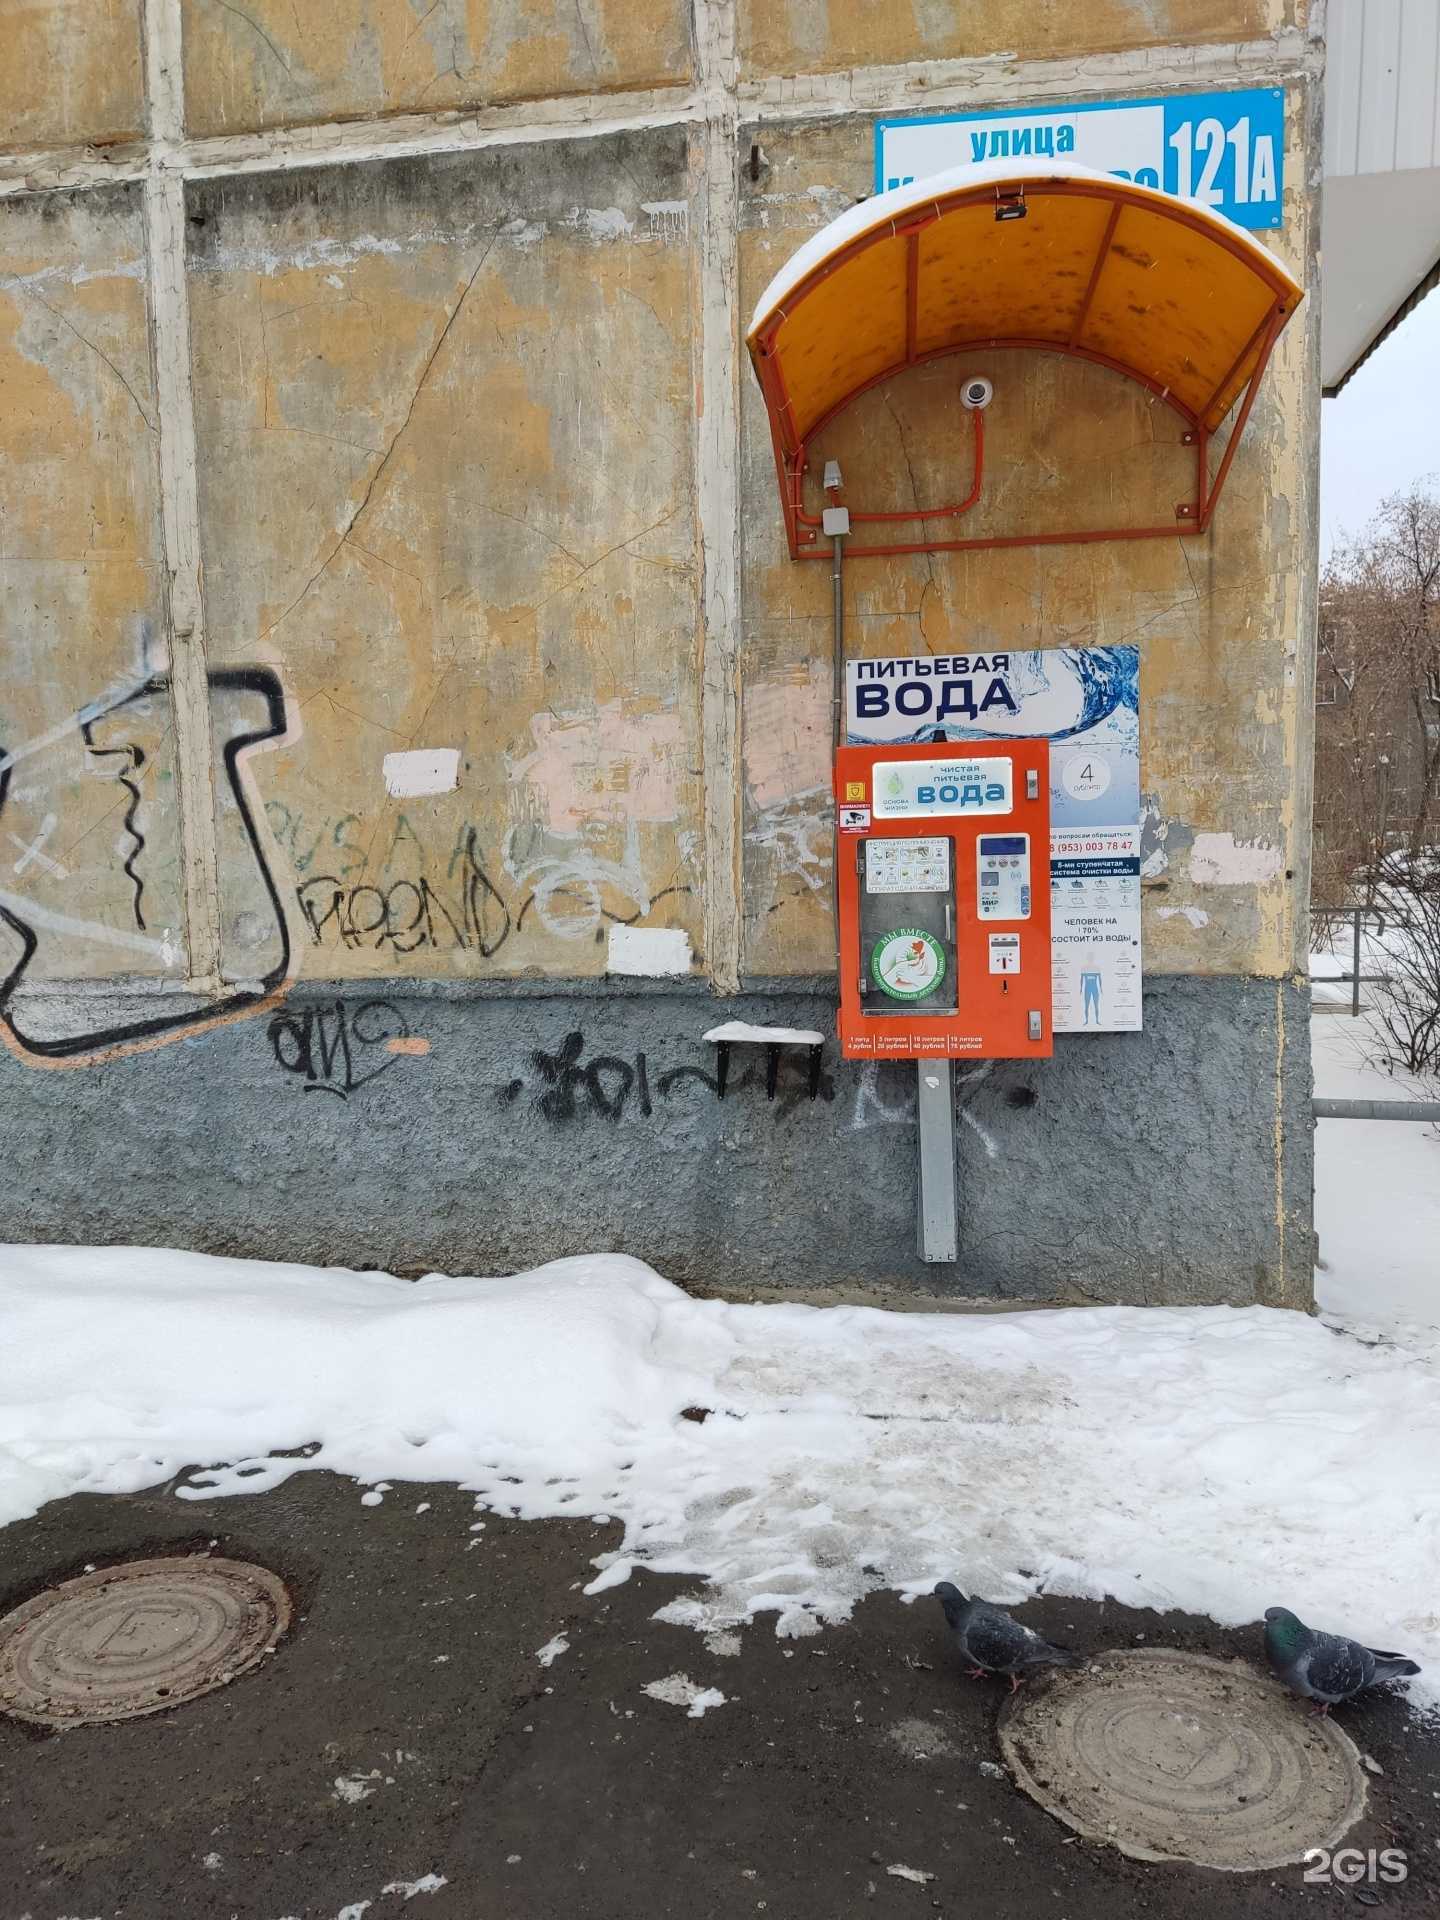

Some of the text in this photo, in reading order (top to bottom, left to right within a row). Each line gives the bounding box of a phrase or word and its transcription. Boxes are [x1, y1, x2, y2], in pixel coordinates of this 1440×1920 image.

[970, 124, 1075, 163] улица
[1169, 116, 1277, 206] 121А
[857, 654, 1010, 679] ПИТЬЕВАЯ
[855, 678, 1018, 722] ВОДА
[940, 765, 980, 773] чистая
[1080, 763, 1095, 782] 4
[933, 774, 987, 783] питьевая
[917, 783, 1006, 808] вода
[1058, 842, 1083, 853] (953)
[1085, 841, 1104, 851] 003
[1106, 841, 1119, 850] 78
[1121, 841, 1133, 849] 47
[1076, 860, 1124, 869] ступенчатая
[1064, 917, 1118, 926] ЧЕЛОВЕК НА
[1052, 935, 1090, 943] СОСТОИТ
[1105, 934, 1131, 942] ВОДЫ
